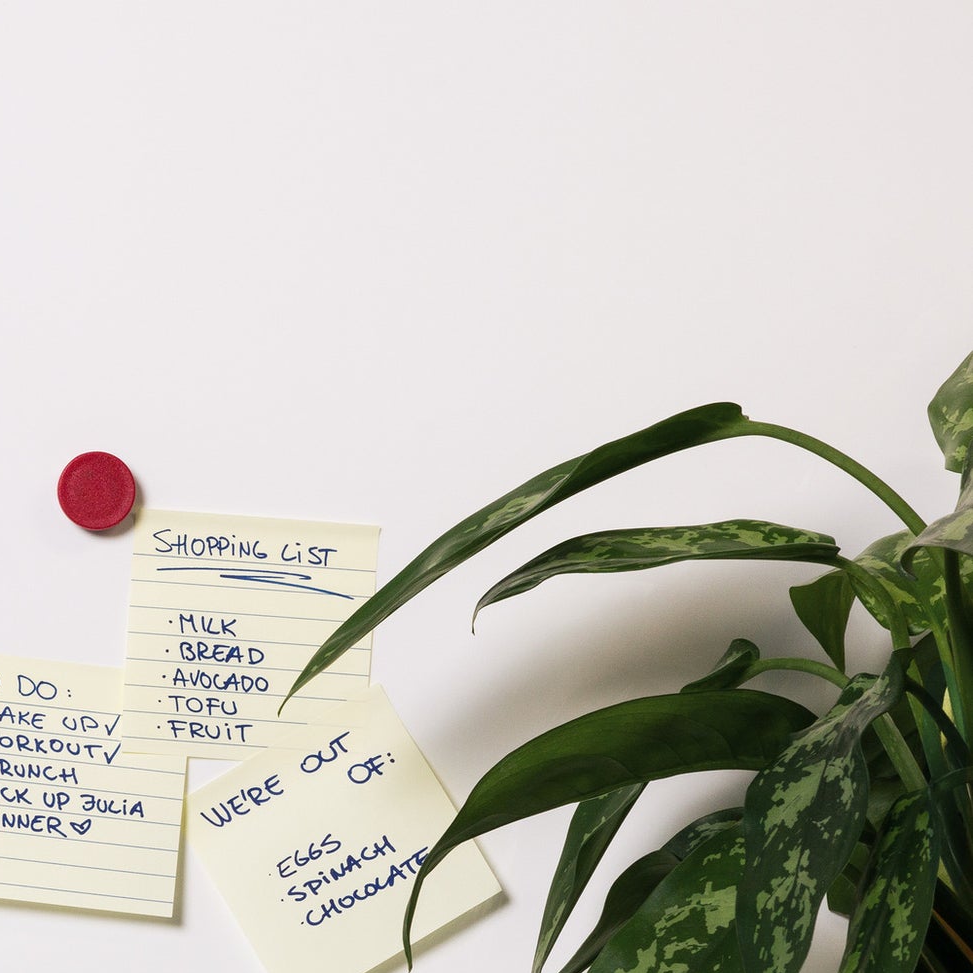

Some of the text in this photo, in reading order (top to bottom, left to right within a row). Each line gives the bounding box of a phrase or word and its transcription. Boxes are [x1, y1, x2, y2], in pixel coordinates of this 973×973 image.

[179, 614, 237, 637] MILK
[179, 641, 265, 664] BREAD
[173, 668, 269, 692] AVOCADO
[168, 695, 237, 716] TOFU
[62, 716, 99, 732] UP
[200, 731, 350, 828] WE'RE OUT
[43, 792, 70, 810] UP
[276, 833, 342, 878] EGGS
[305, 847, 429, 926] CHOCOLATE
